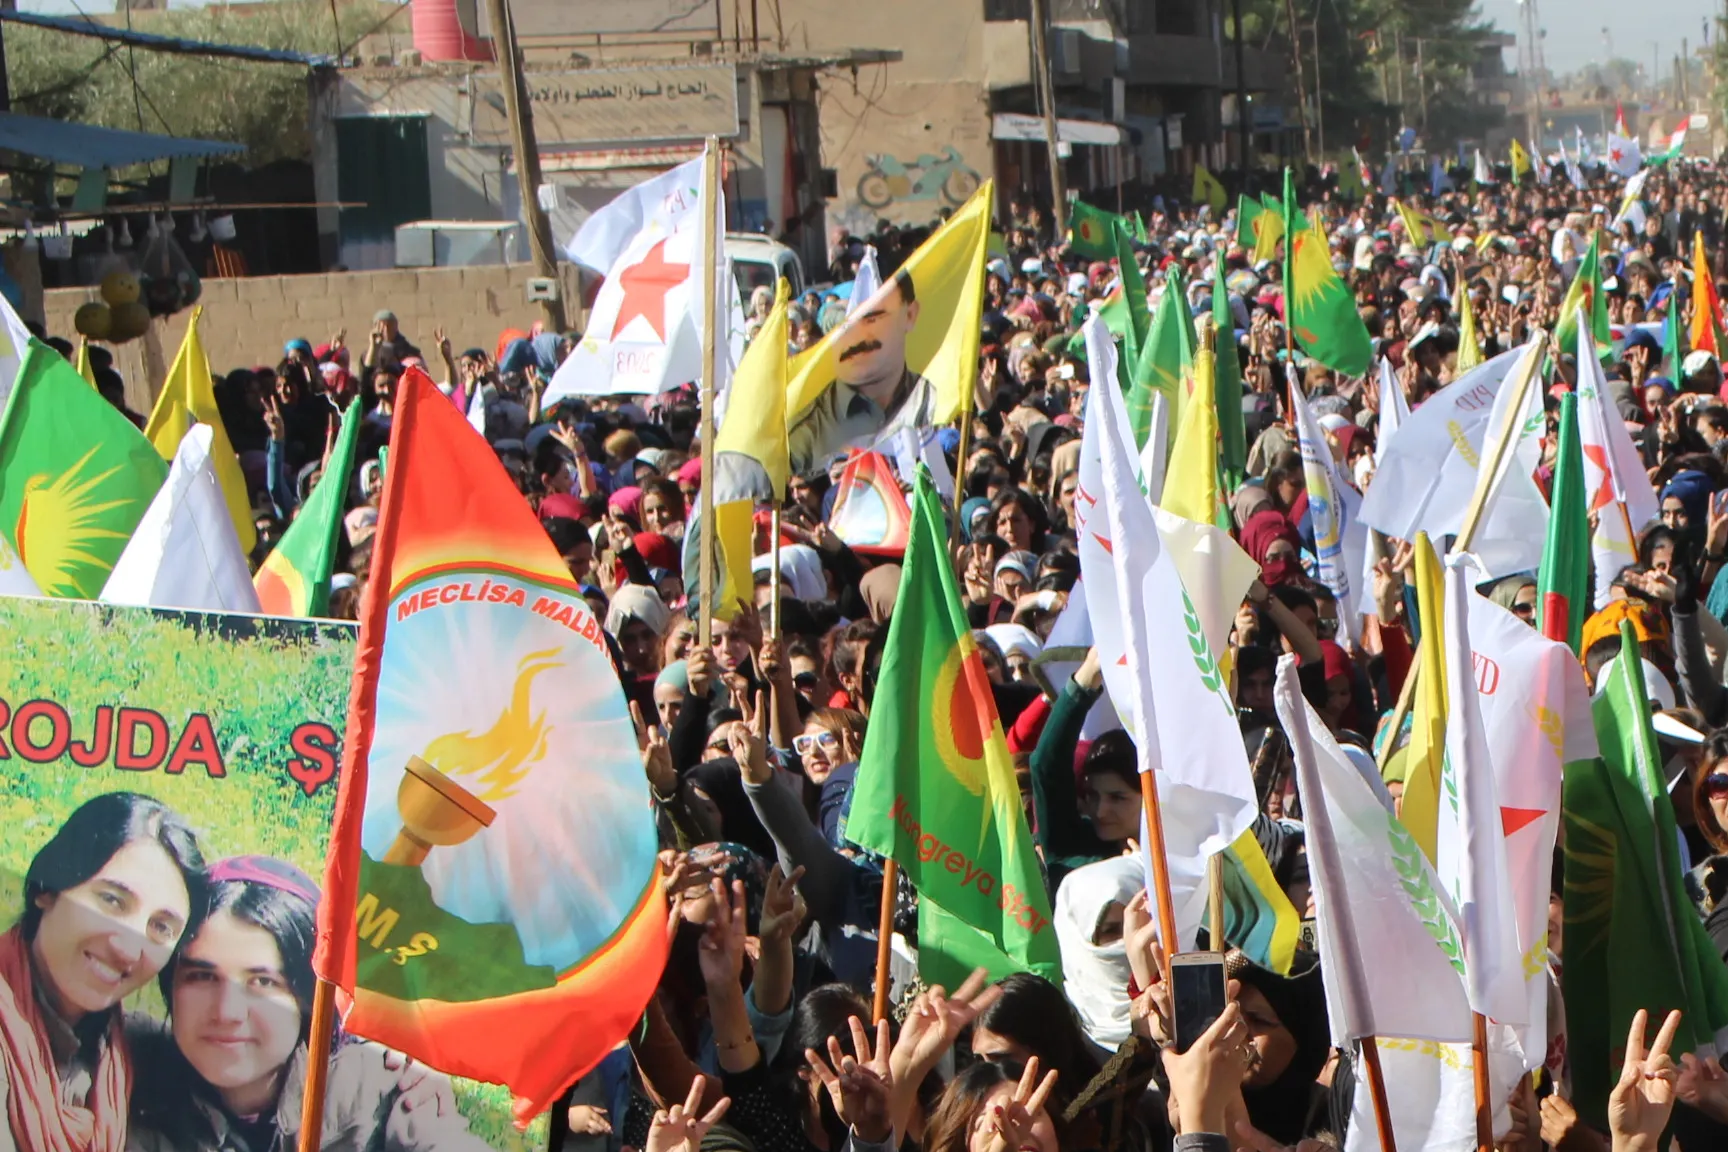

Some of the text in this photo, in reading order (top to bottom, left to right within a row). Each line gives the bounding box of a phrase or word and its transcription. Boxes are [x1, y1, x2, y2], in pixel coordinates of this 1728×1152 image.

[666, 81, 708, 99] الحاج
[888, 793, 1050, 935] Kongreya Star
